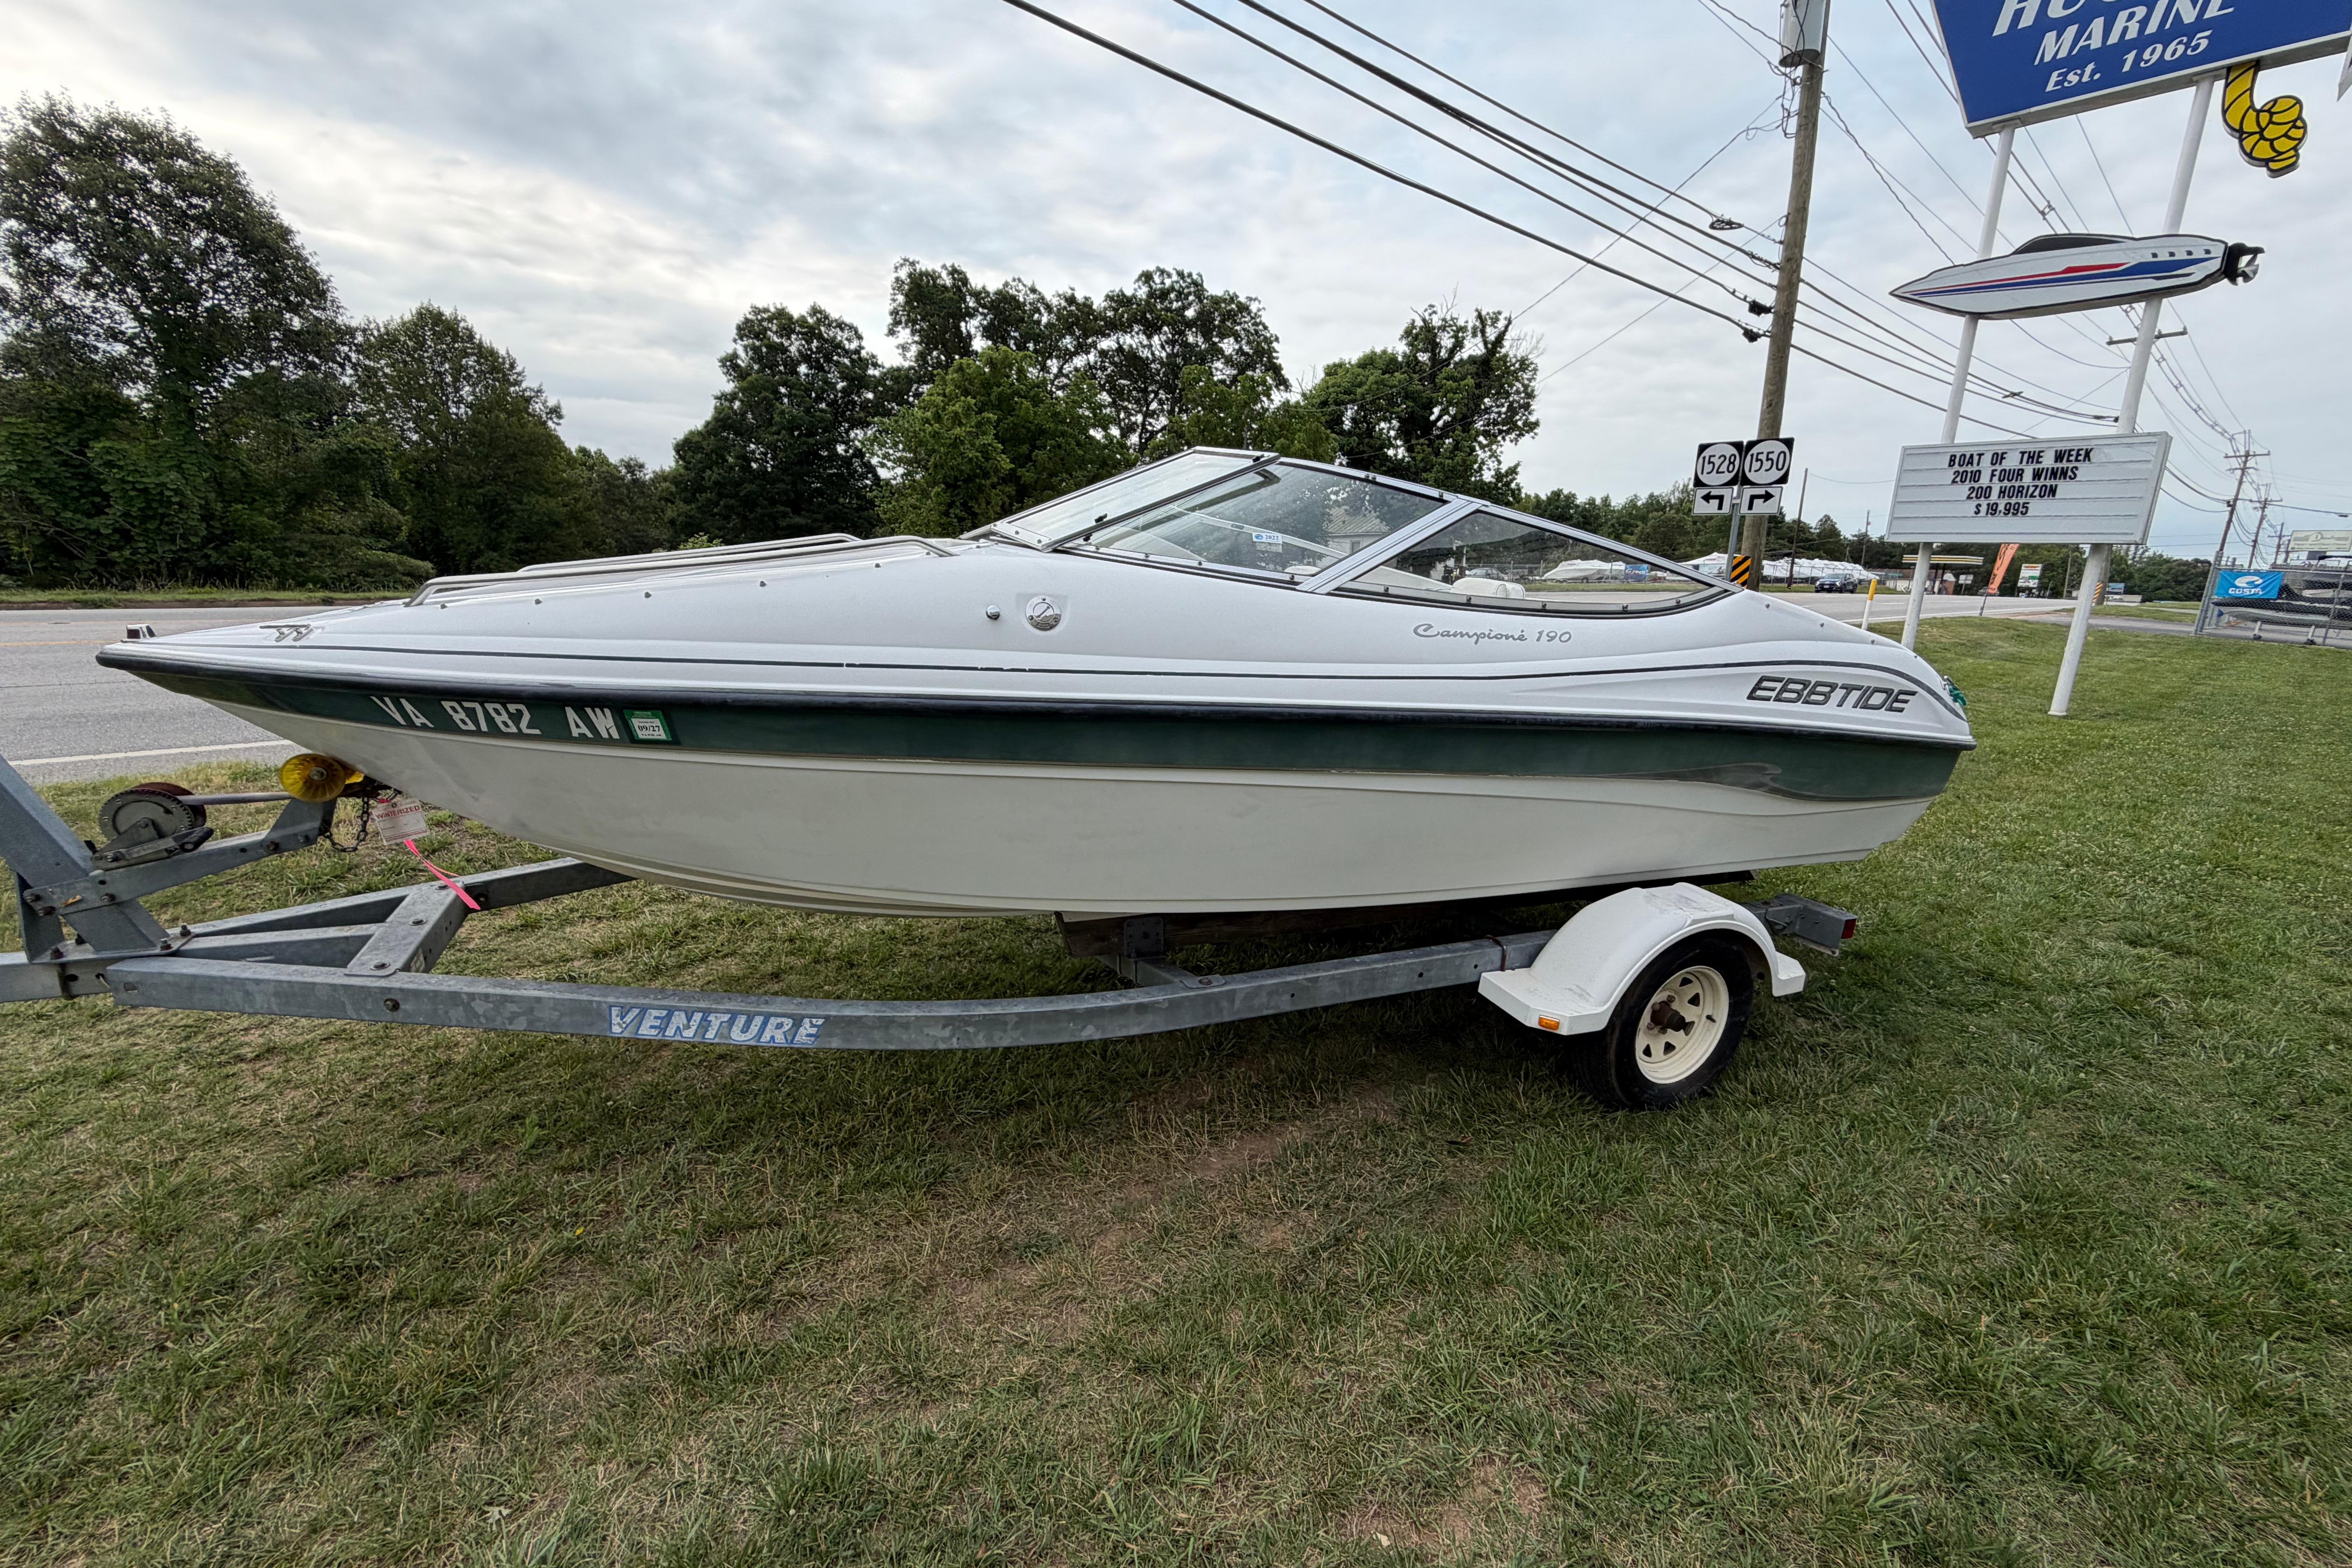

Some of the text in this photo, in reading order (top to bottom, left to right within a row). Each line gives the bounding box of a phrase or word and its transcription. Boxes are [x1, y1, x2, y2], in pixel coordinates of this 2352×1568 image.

[2045, 30, 2213, 92] Est. 1965
[1701, 454, 1737, 475] 1528
[1748, 450, 1787, 473] 1550
[1948, 448, 2094, 468] BOAT OF THE WEEK
[1951, 466, 2079, 484] 2010 FOUR WINNS
[1966, 484, 2058, 500] 200 HORIZON
[1535, 630, 1572, 643] 190
[1746, 675, 1918, 713] EBBTIDE
[370, 696, 620, 739] VA 8782 AW
[375, 805, 420, 819] WINTERIZED
[609, 1005, 825, 1046] VENTURE
